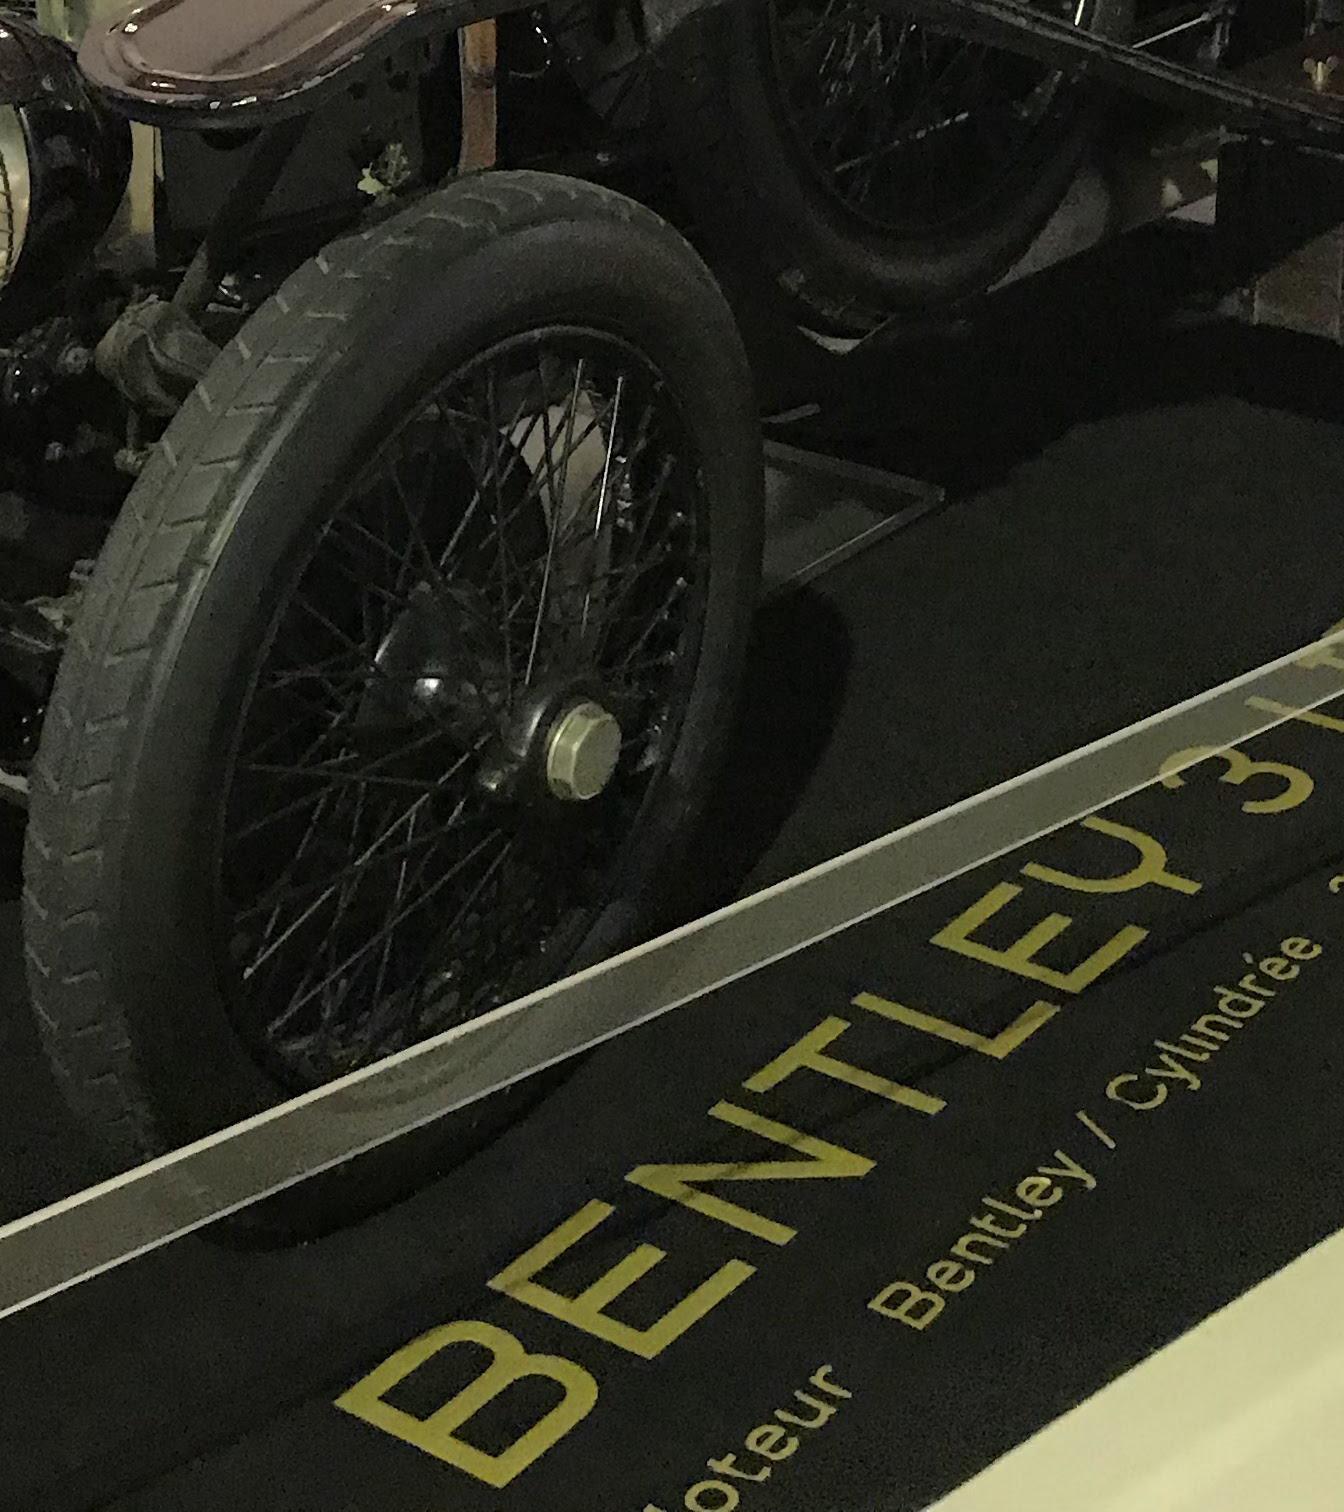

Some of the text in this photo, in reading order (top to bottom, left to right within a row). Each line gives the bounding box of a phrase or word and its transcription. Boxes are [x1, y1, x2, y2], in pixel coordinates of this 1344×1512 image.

[334, 816, 1203, 1489] BENTLEY
[1160, 744, 1315, 815] 3
[642, 1363, 854, 1512] oteur
[867, 1150, 1098, 1331] Bentley
[1075, 1109, 1117, 1150] /
[1105, 934, 1324, 1111] Cylindrée
